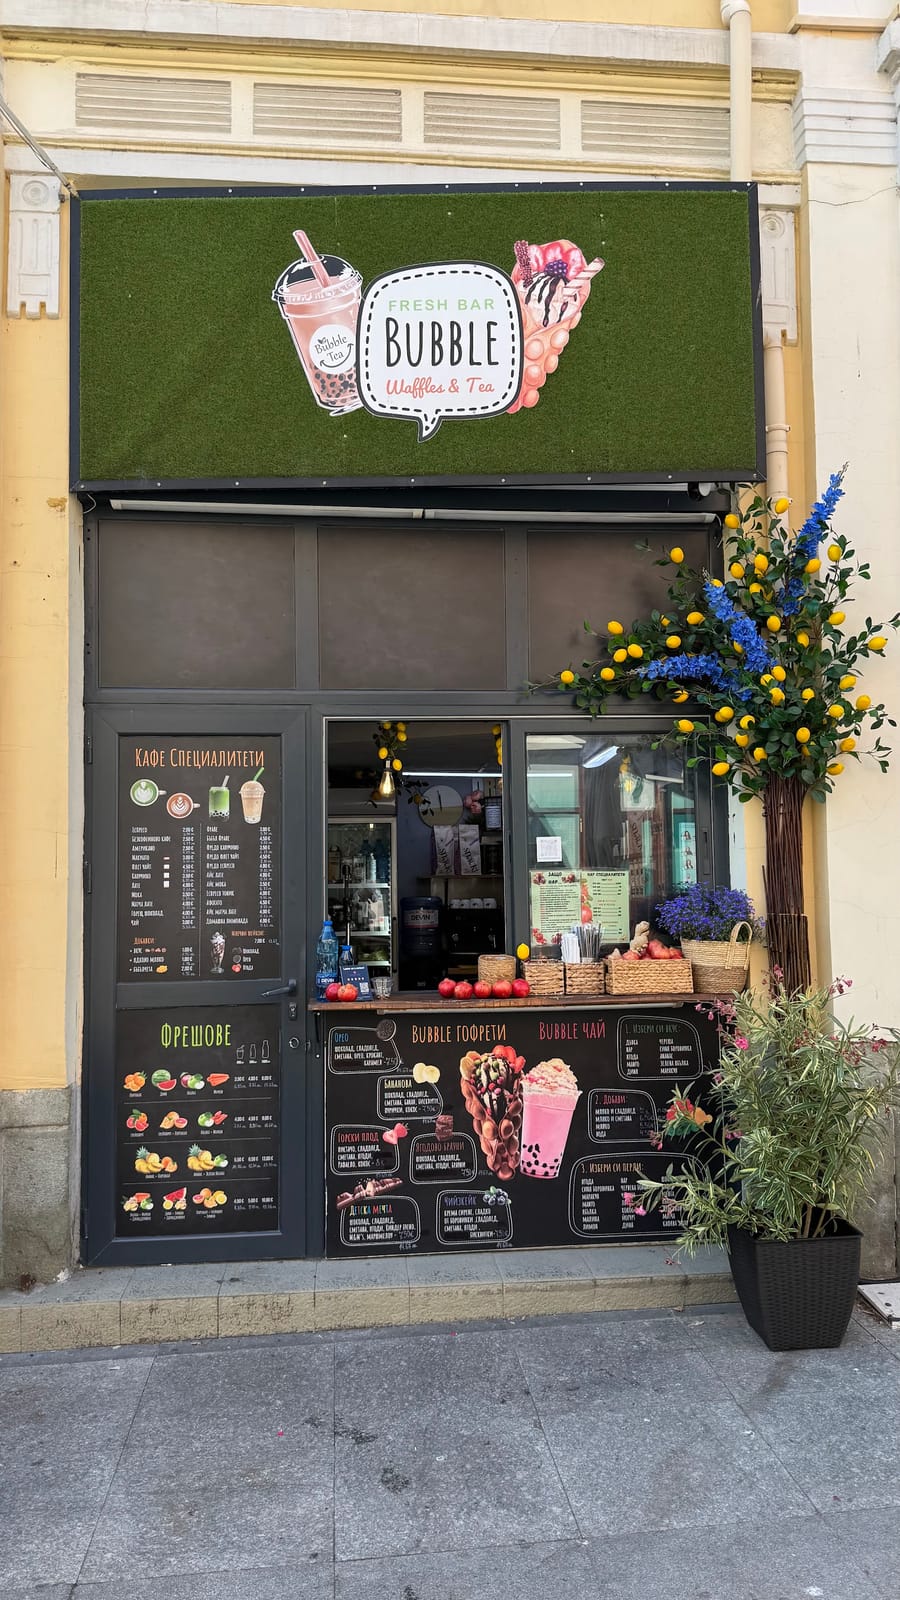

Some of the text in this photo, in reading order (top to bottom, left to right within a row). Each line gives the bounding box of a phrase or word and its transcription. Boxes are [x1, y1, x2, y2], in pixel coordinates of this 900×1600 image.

[388, 298, 495, 311] FRESH BAR
[314, 333, 348, 354] Bubble
[385, 316, 499, 367] BUBBLE
[326, 351, 344, 362] Tea
[386, 376, 495, 399] Waffles & Tea
[135, 748, 264, 769] КАФЕ СПЕЦИАЛИТЕТИ
[160, 1022, 231, 1048] ФРЕШОВЕ
[412, 1024, 507, 1043] BUBBLE ГОФРЕТИ
[539, 1018, 606, 1040] BUBBLE ЧАЙ
